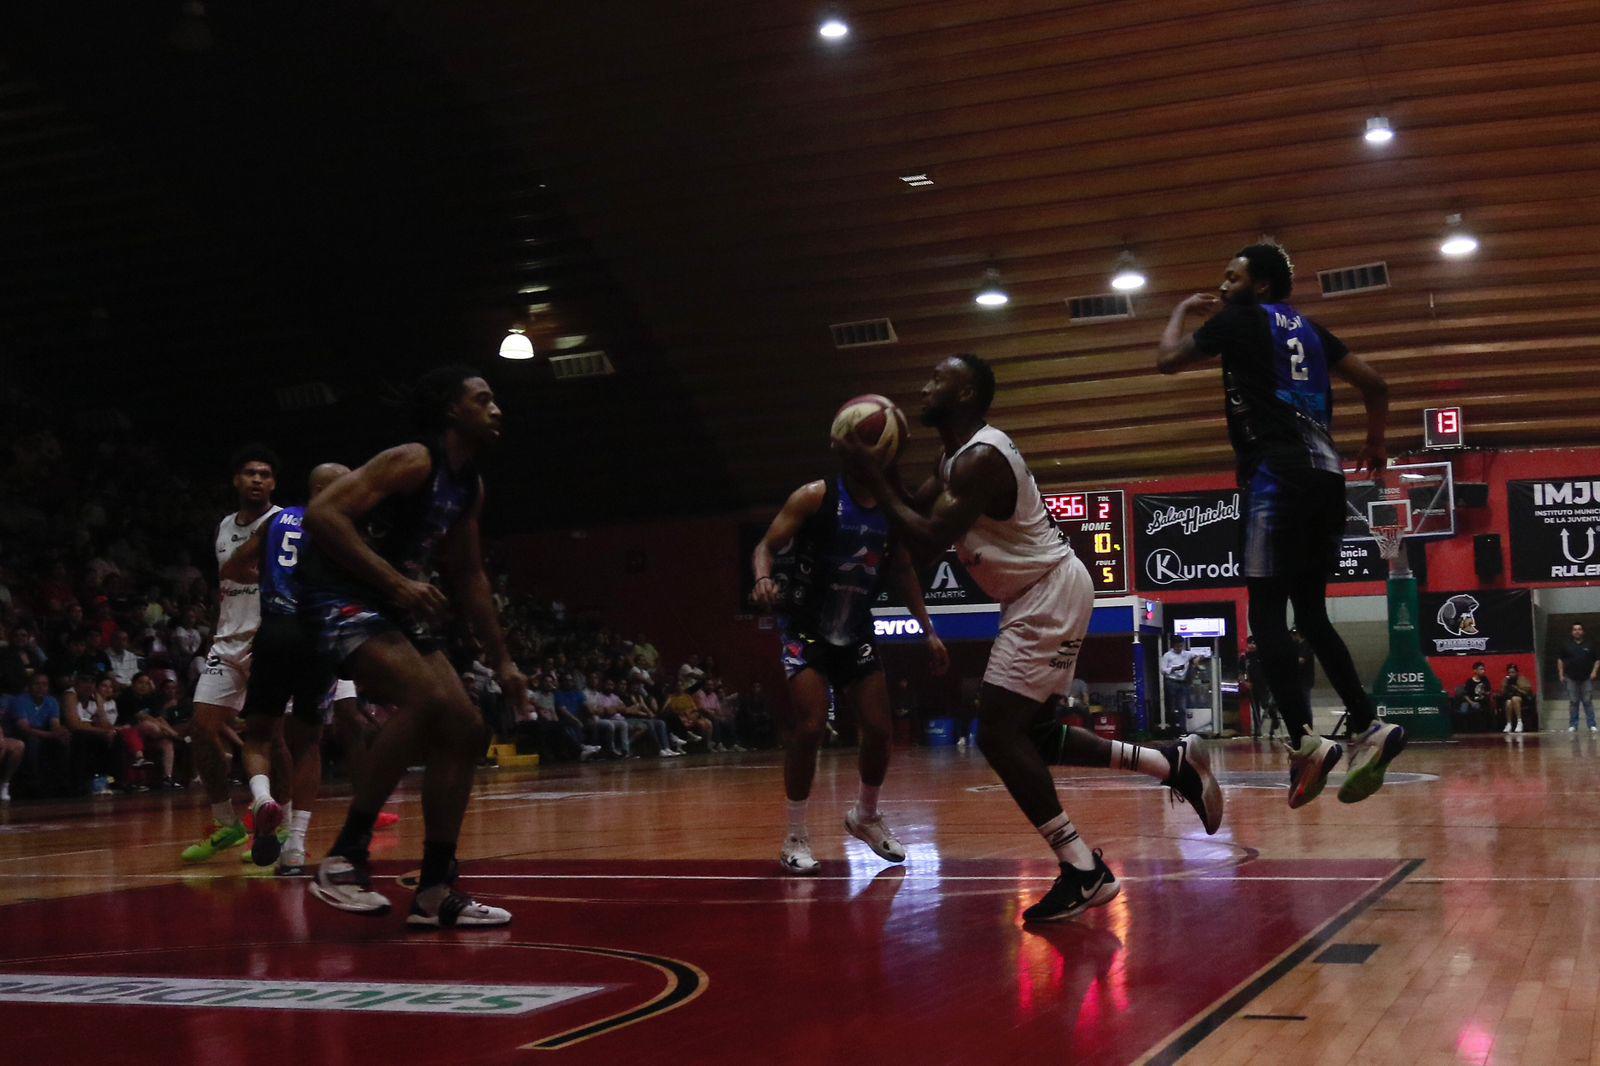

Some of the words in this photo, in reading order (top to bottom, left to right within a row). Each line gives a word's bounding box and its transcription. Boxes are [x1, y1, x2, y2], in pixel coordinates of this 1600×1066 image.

[1287, 337, 1309, 381] 2
[1437, 411, 1457, 433] 13
[1099, 503, 1109, 518] 2
[1146, 505, 1186, 535] Salsa
[1181, 493, 1240, 535] Huichol
[1534, 509, 1573, 517] INSTITUTO
[1081, 521, 1112, 532] HOME
[277, 531, 302, 567] 5
[1102, 566, 1114, 583] 5
[924, 590, 967, 600] ANTARTIC
[1397, 672, 1424, 683] ISDE
